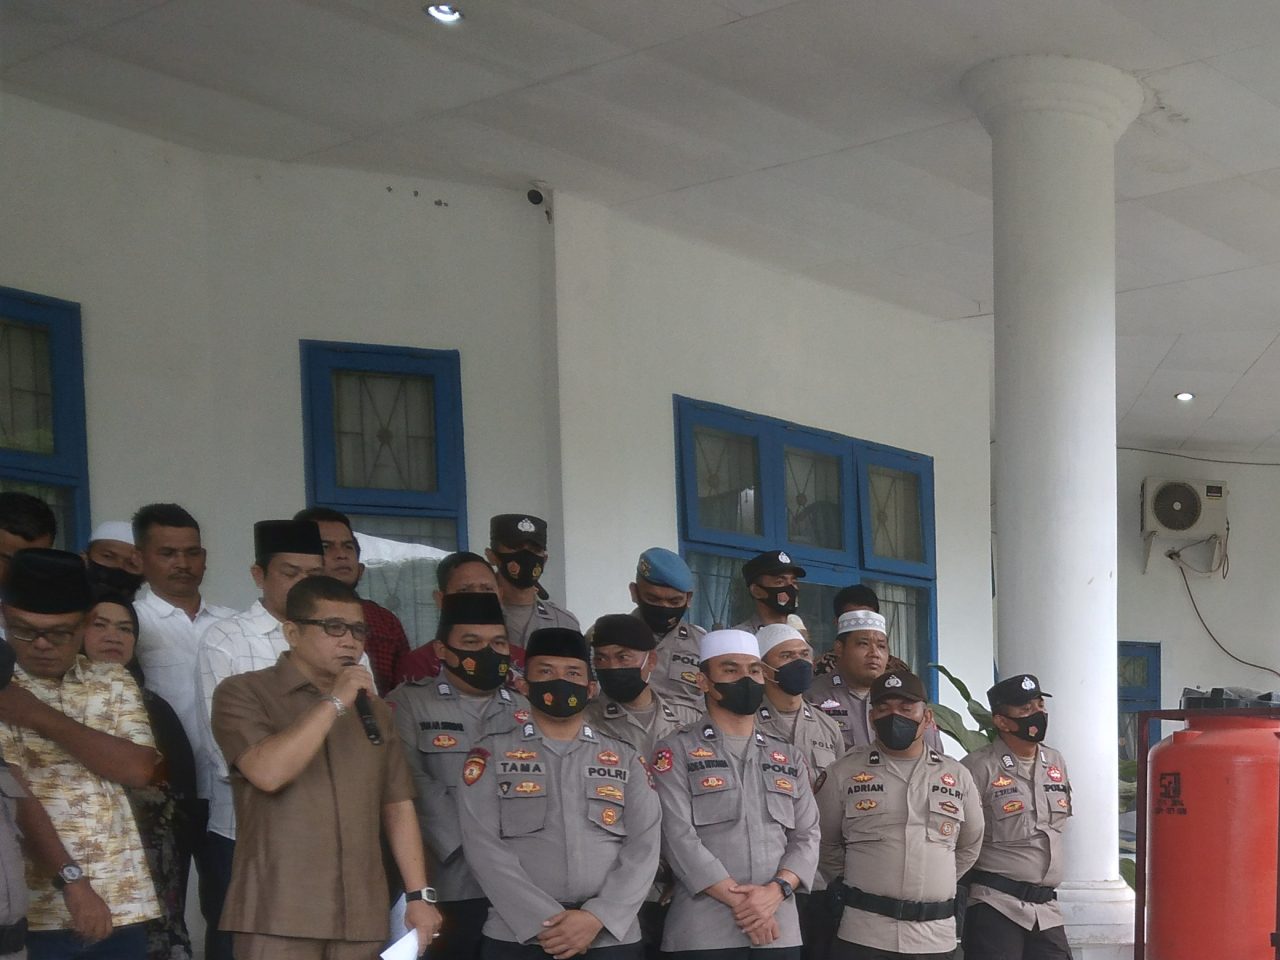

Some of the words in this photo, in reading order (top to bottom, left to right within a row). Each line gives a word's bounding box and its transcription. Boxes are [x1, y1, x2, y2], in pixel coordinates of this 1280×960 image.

[501, 762, 542, 773] TAMA
[588, 767, 627, 781] POLRI
[762, 763, 798, 778] POLRI
[847, 784, 884, 795] ADRIAN
[932, 785, 964, 801] POLRI
